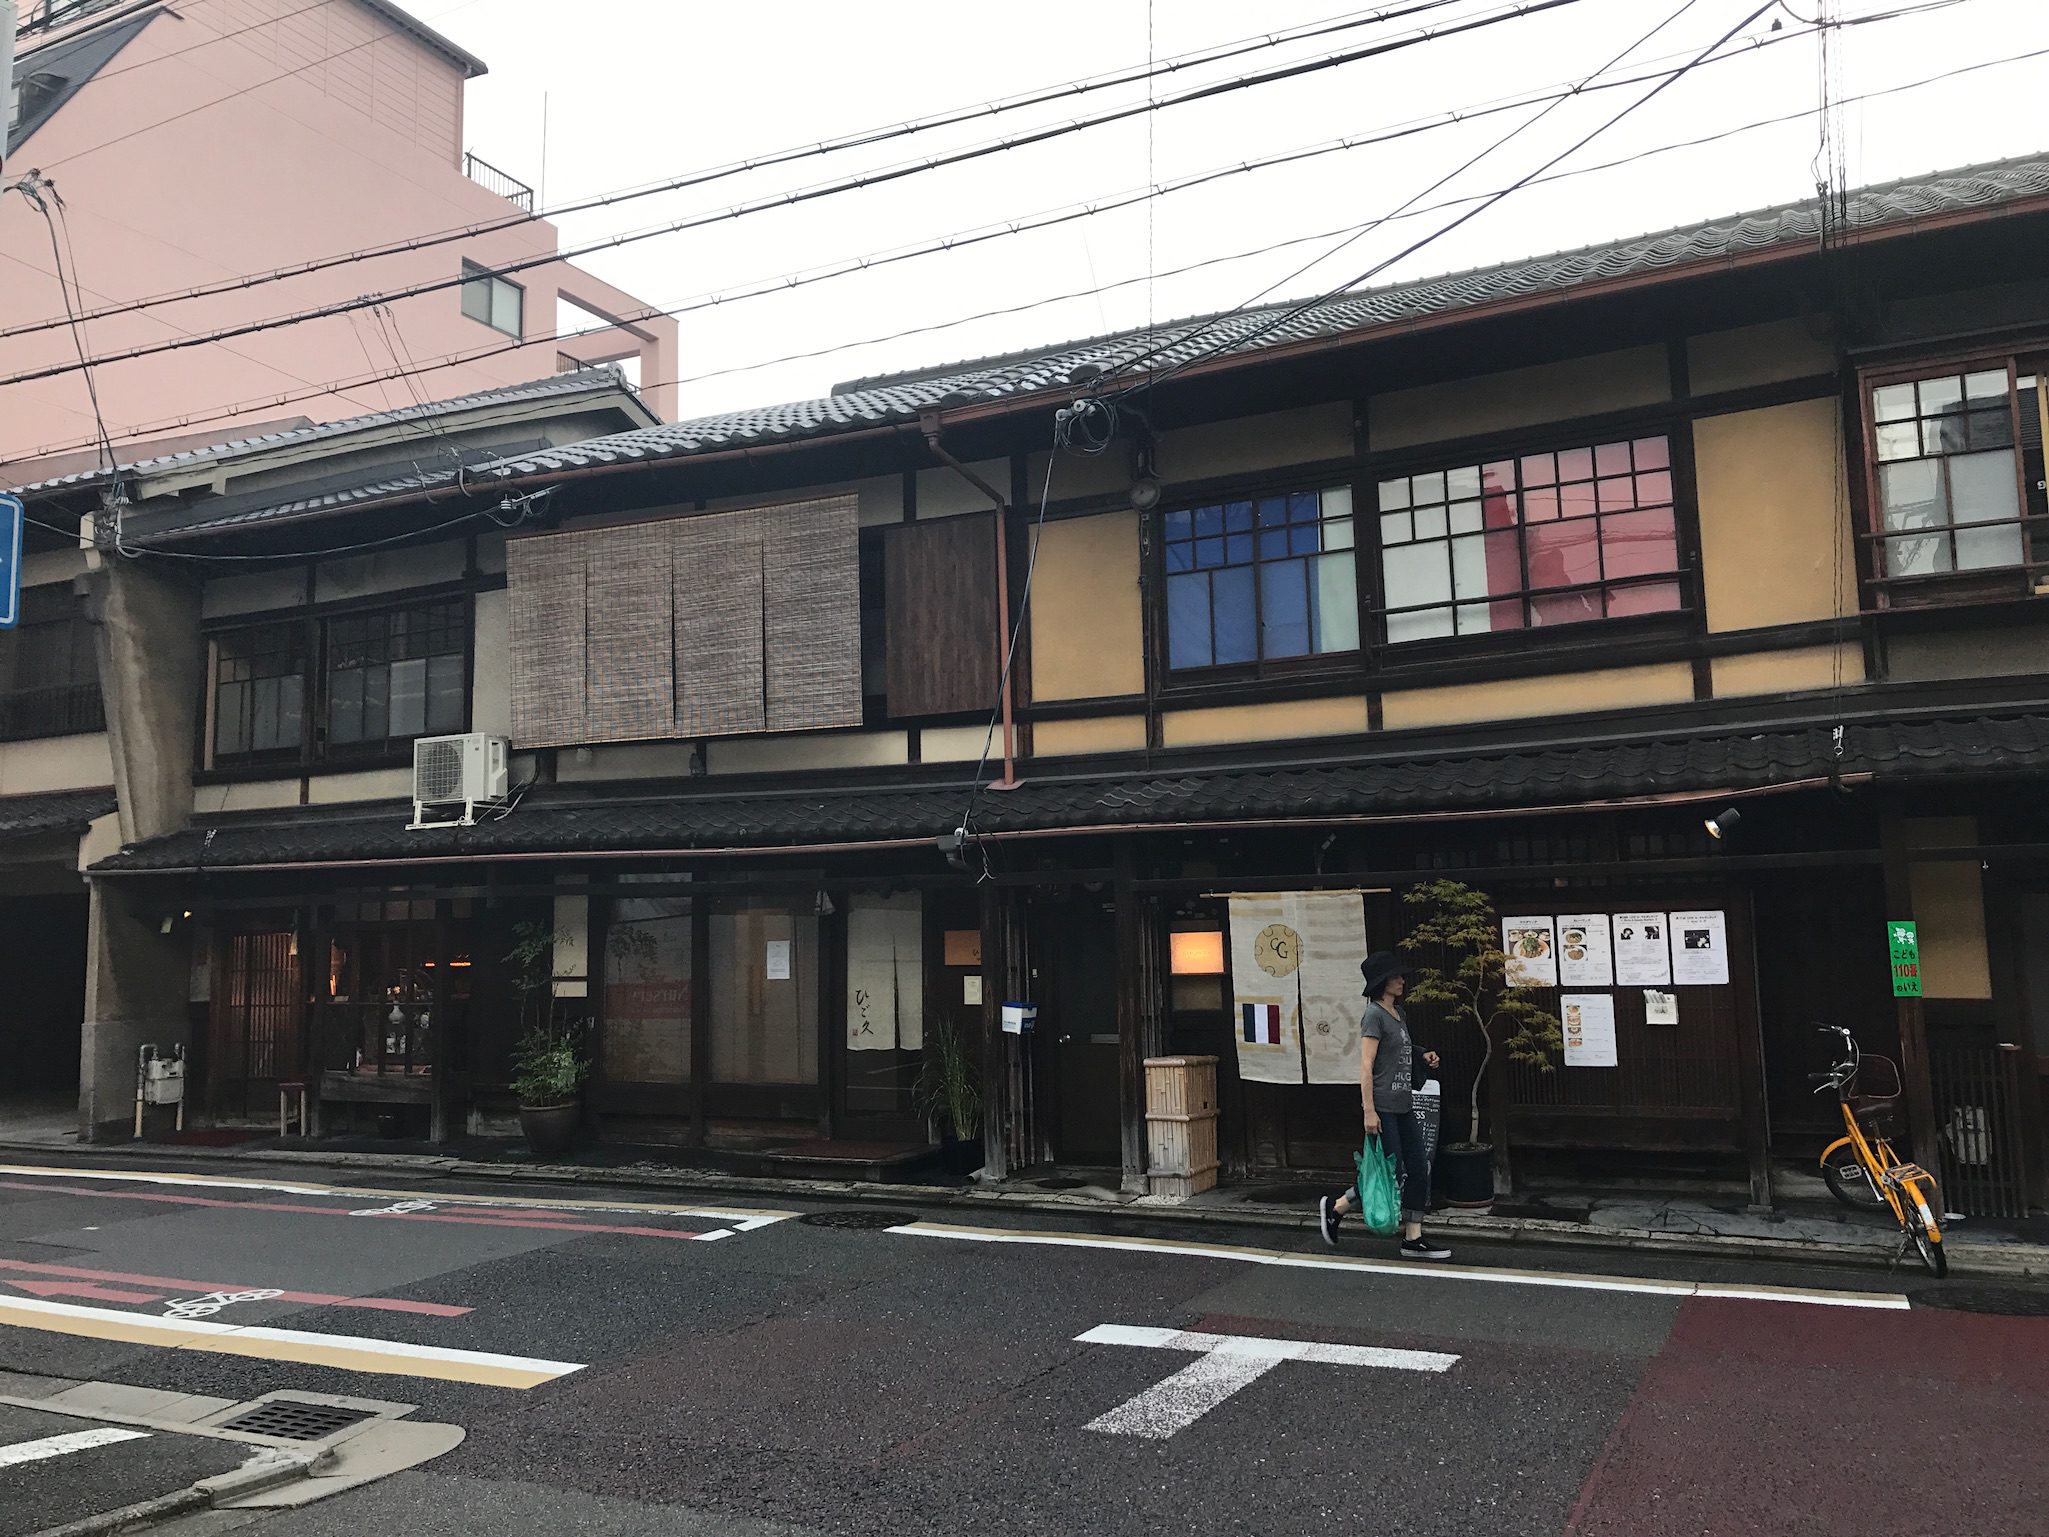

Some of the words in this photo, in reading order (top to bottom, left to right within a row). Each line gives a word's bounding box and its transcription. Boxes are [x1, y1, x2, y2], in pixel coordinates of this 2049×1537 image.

[1893, 949, 1915, 959] こども
[1896, 982, 1918, 992] のいえ
[855, 989, 874, 1035] ひご久
